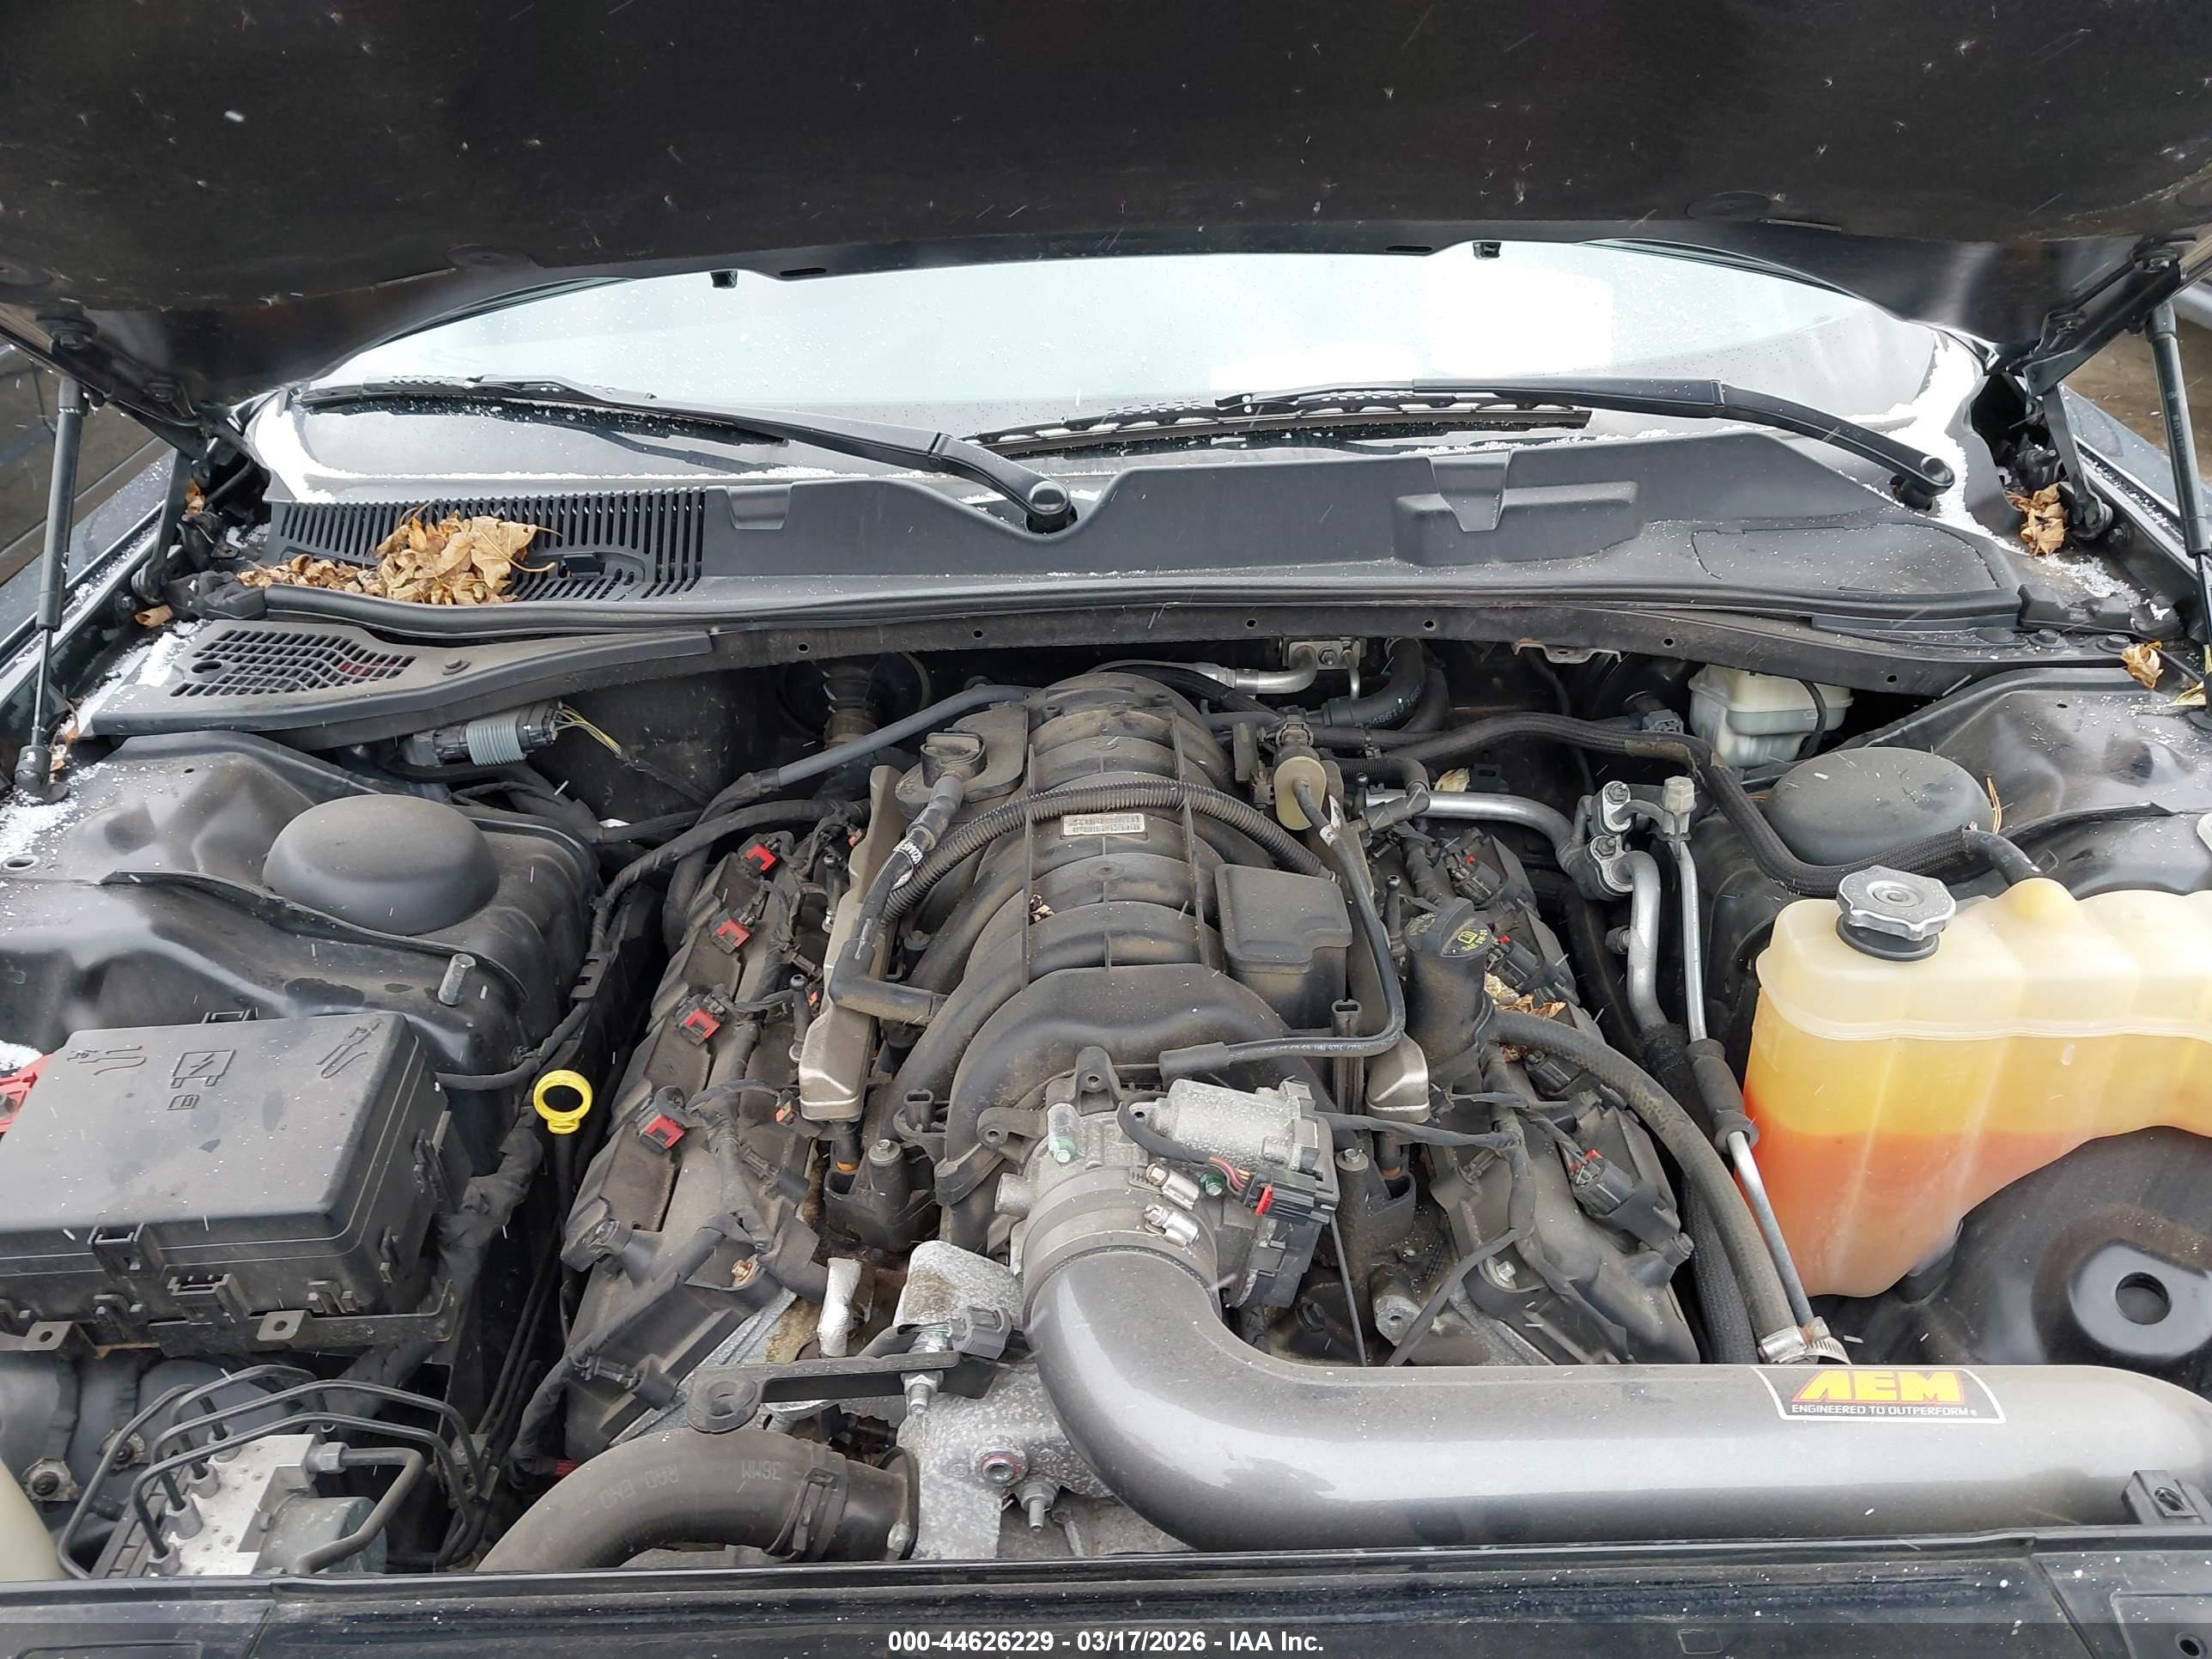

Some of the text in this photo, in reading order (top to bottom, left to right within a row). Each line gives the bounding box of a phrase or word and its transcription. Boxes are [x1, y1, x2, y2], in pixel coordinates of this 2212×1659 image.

[1795, 1370, 1964, 1403] AEM
[1791, 1404, 1968, 1417] ENGINEERED TO OUTPERFORM
